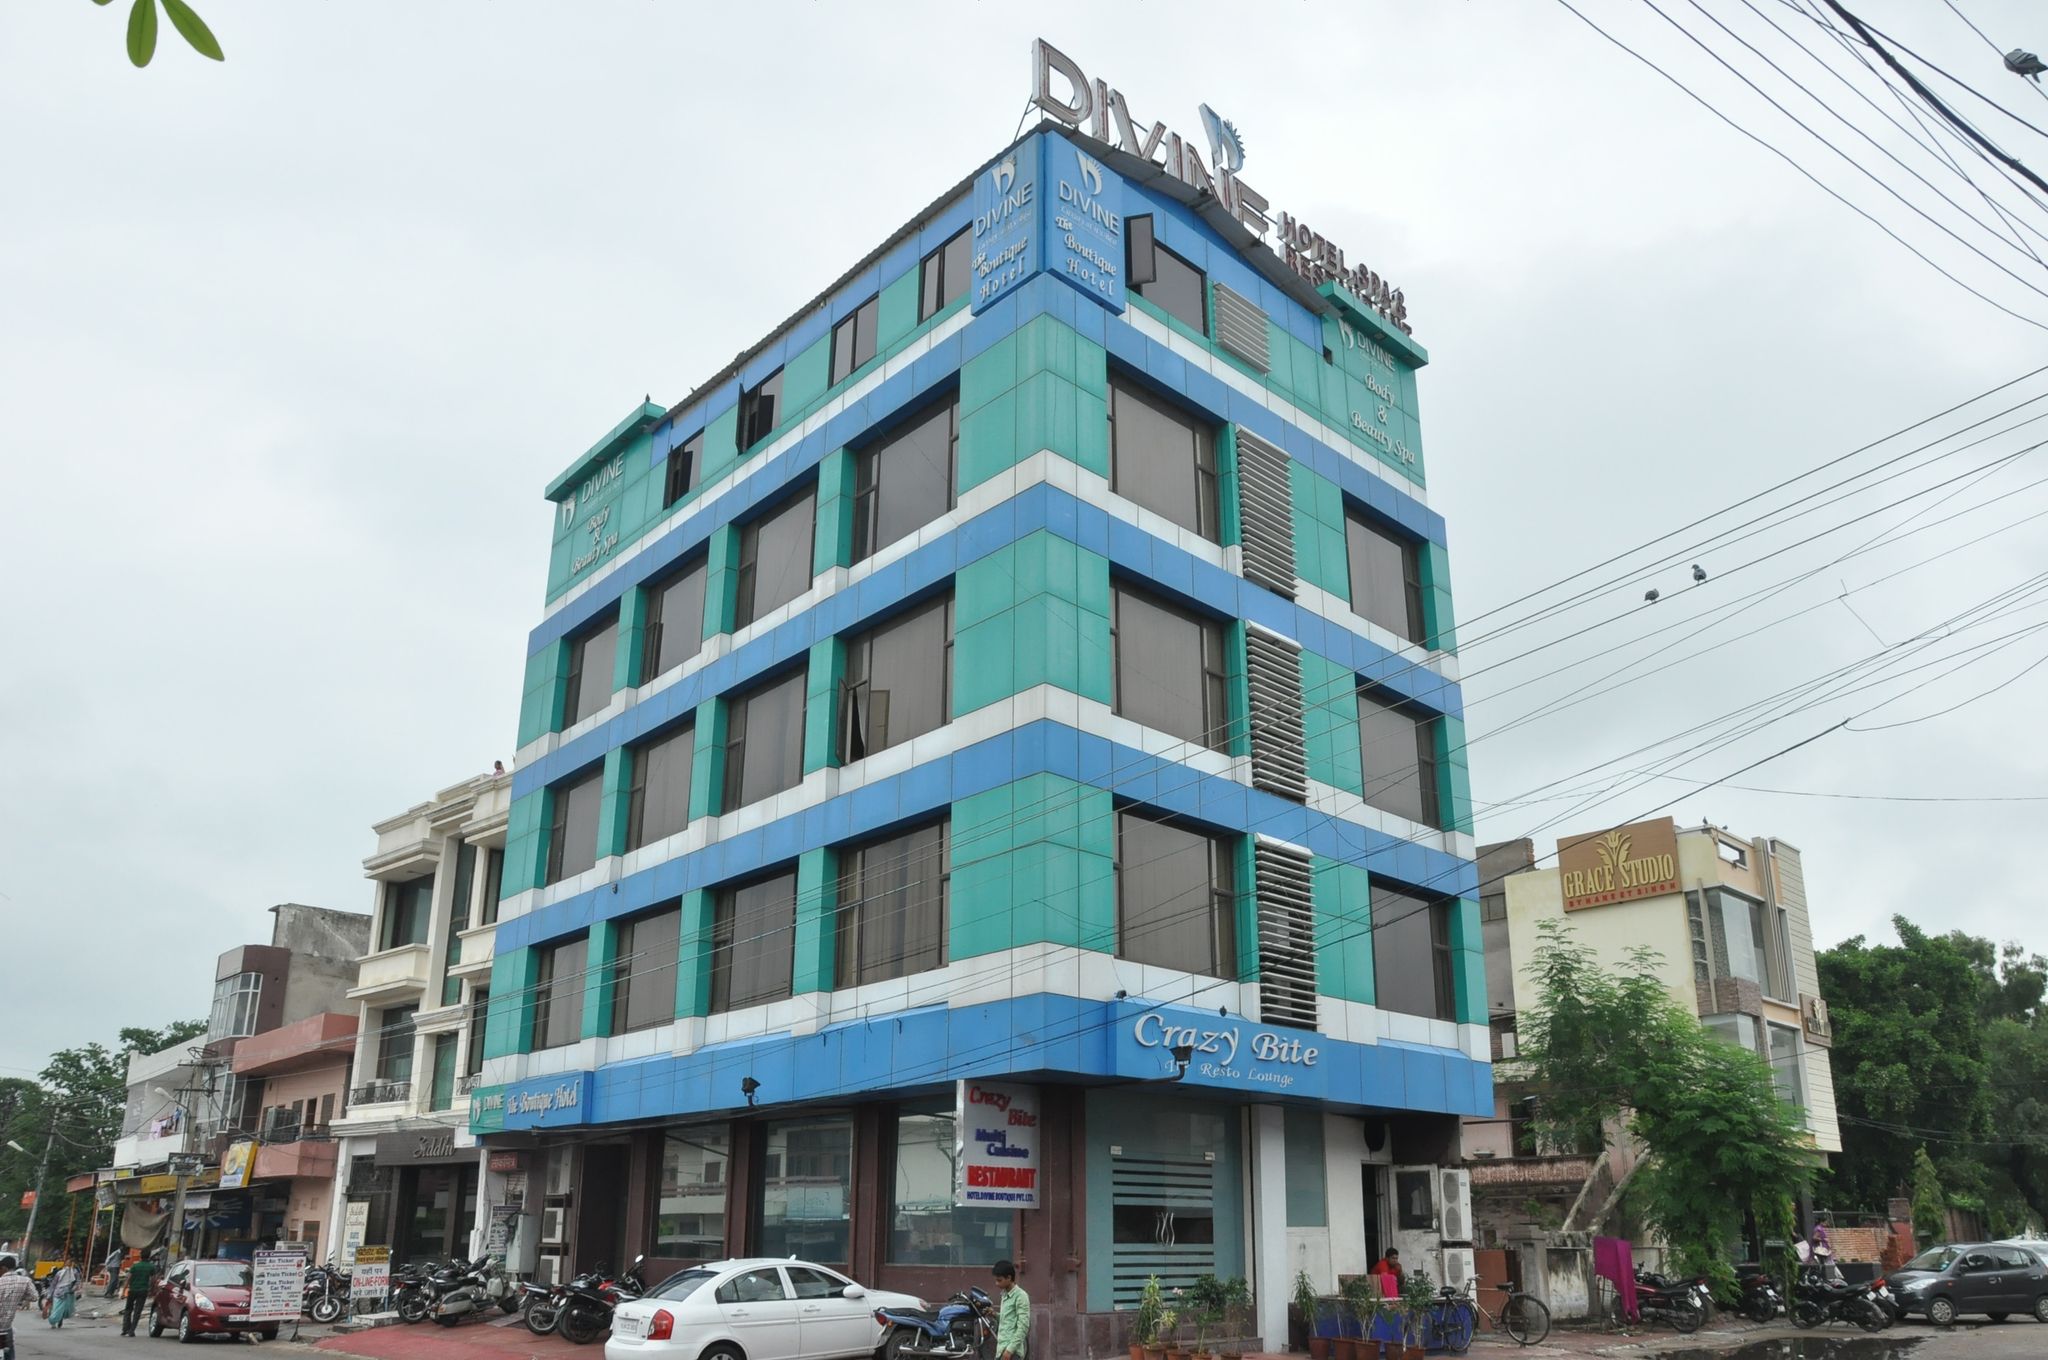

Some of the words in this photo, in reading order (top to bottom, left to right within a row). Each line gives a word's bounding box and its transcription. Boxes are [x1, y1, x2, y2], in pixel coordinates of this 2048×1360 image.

[1032, 37, 1270, 234] DIVINE
[976, 181, 1033, 238] DIVINE
[1055, 216, 1073, 232] The
[1059, 180, 1120, 236] DIVINE
[972, 251, 987, 270] The
[978, 236, 1028, 279] Boutique
[1064, 233, 1117, 276] Boutique
[980, 256, 1024, 302] Hotel
[1067, 257, 1114, 296] Hotel
[1357, 263, 1391, 310] SPA
[1357, 330, 1396, 372] DIVINE
[1365, 373, 1395, 408] Body
[1377, 405, 1388, 425] &
[1352, 410, 1393, 453] Beauty
[1393, 440, 1415, 465] Spa
[582, 452, 625, 504] DIVINE
[1563, 864, 1615, 898] GRACE
[1620, 853, 1675, 889] STUDIO
[1134, 1013, 1239, 1066] Crazy
[1252, 1032, 1319, 1066] Bite
[1200, 1063, 1240, 1079] Resto
[1248, 1069, 1294, 1088] Lounge
[483, 1093, 504, 1111] DIVINE
[520, 1091, 553, 1119] Boutique
[553, 1080, 580, 1111] Hotel
[969, 1086, 1011, 1112] Crazy
[1007, 1108, 1037, 1127] Bite
[975, 1128, 1006, 1143] Multi
[986, 1143, 1029, 1159] Cuisine
[967, 1165, 1036, 1189] RESTAURANT
[967, 1191, 981, 1200] HOTEL
[981, 1191, 995, 1201] DIVINE
